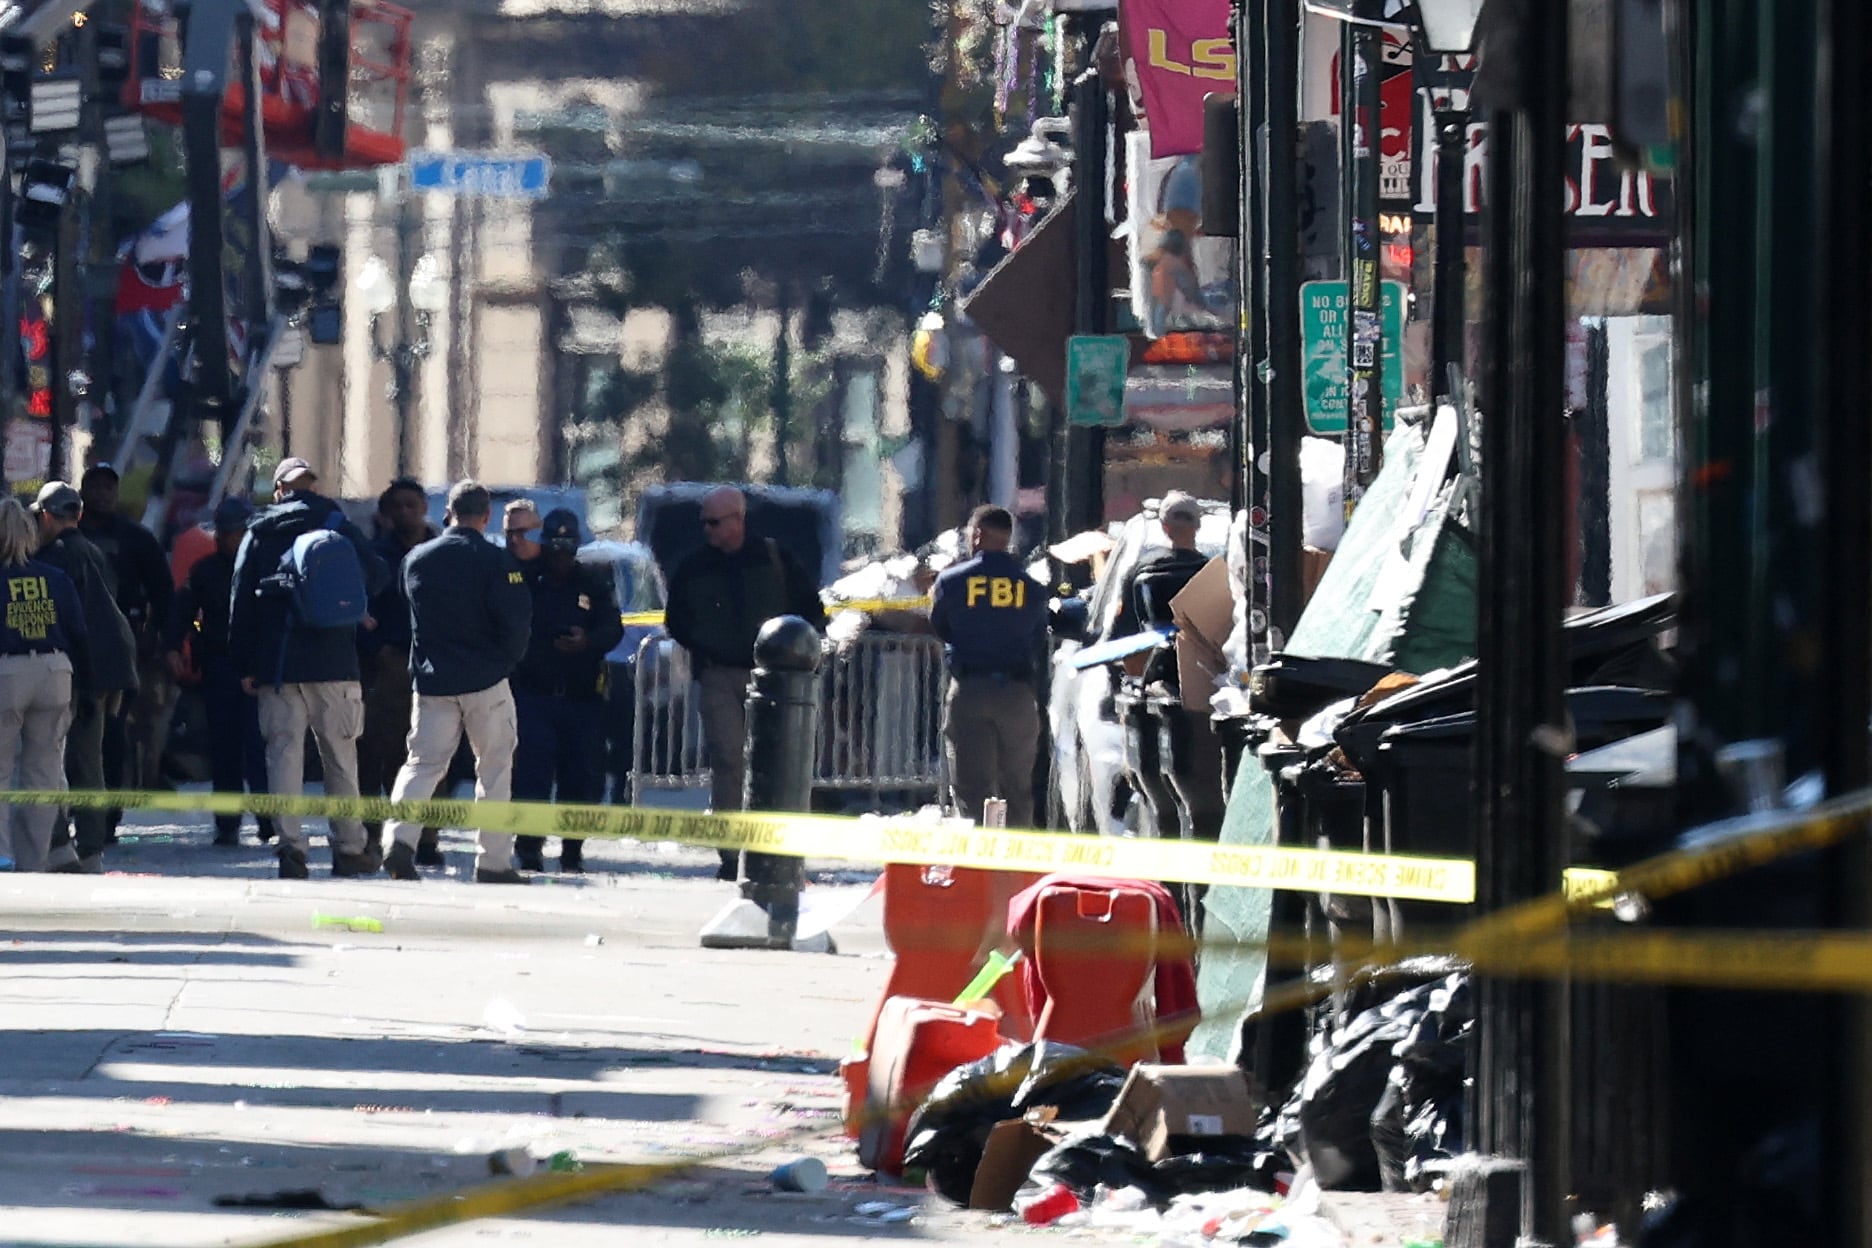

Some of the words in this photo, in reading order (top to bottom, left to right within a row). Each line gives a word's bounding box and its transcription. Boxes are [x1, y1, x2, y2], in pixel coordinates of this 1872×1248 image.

[8, 576, 48, 602] FBI
[967, 576, 1025, 608] FBI
[7, 599, 55, 615] EVIDENCE
[679, 816, 730, 841] SCENE
[733, 820, 786, 847] CRIME
[1209, 851, 1260, 876] CROSS
[1334, 861, 1388, 886] SCENE
[1394, 866, 1448, 892] CRIME
